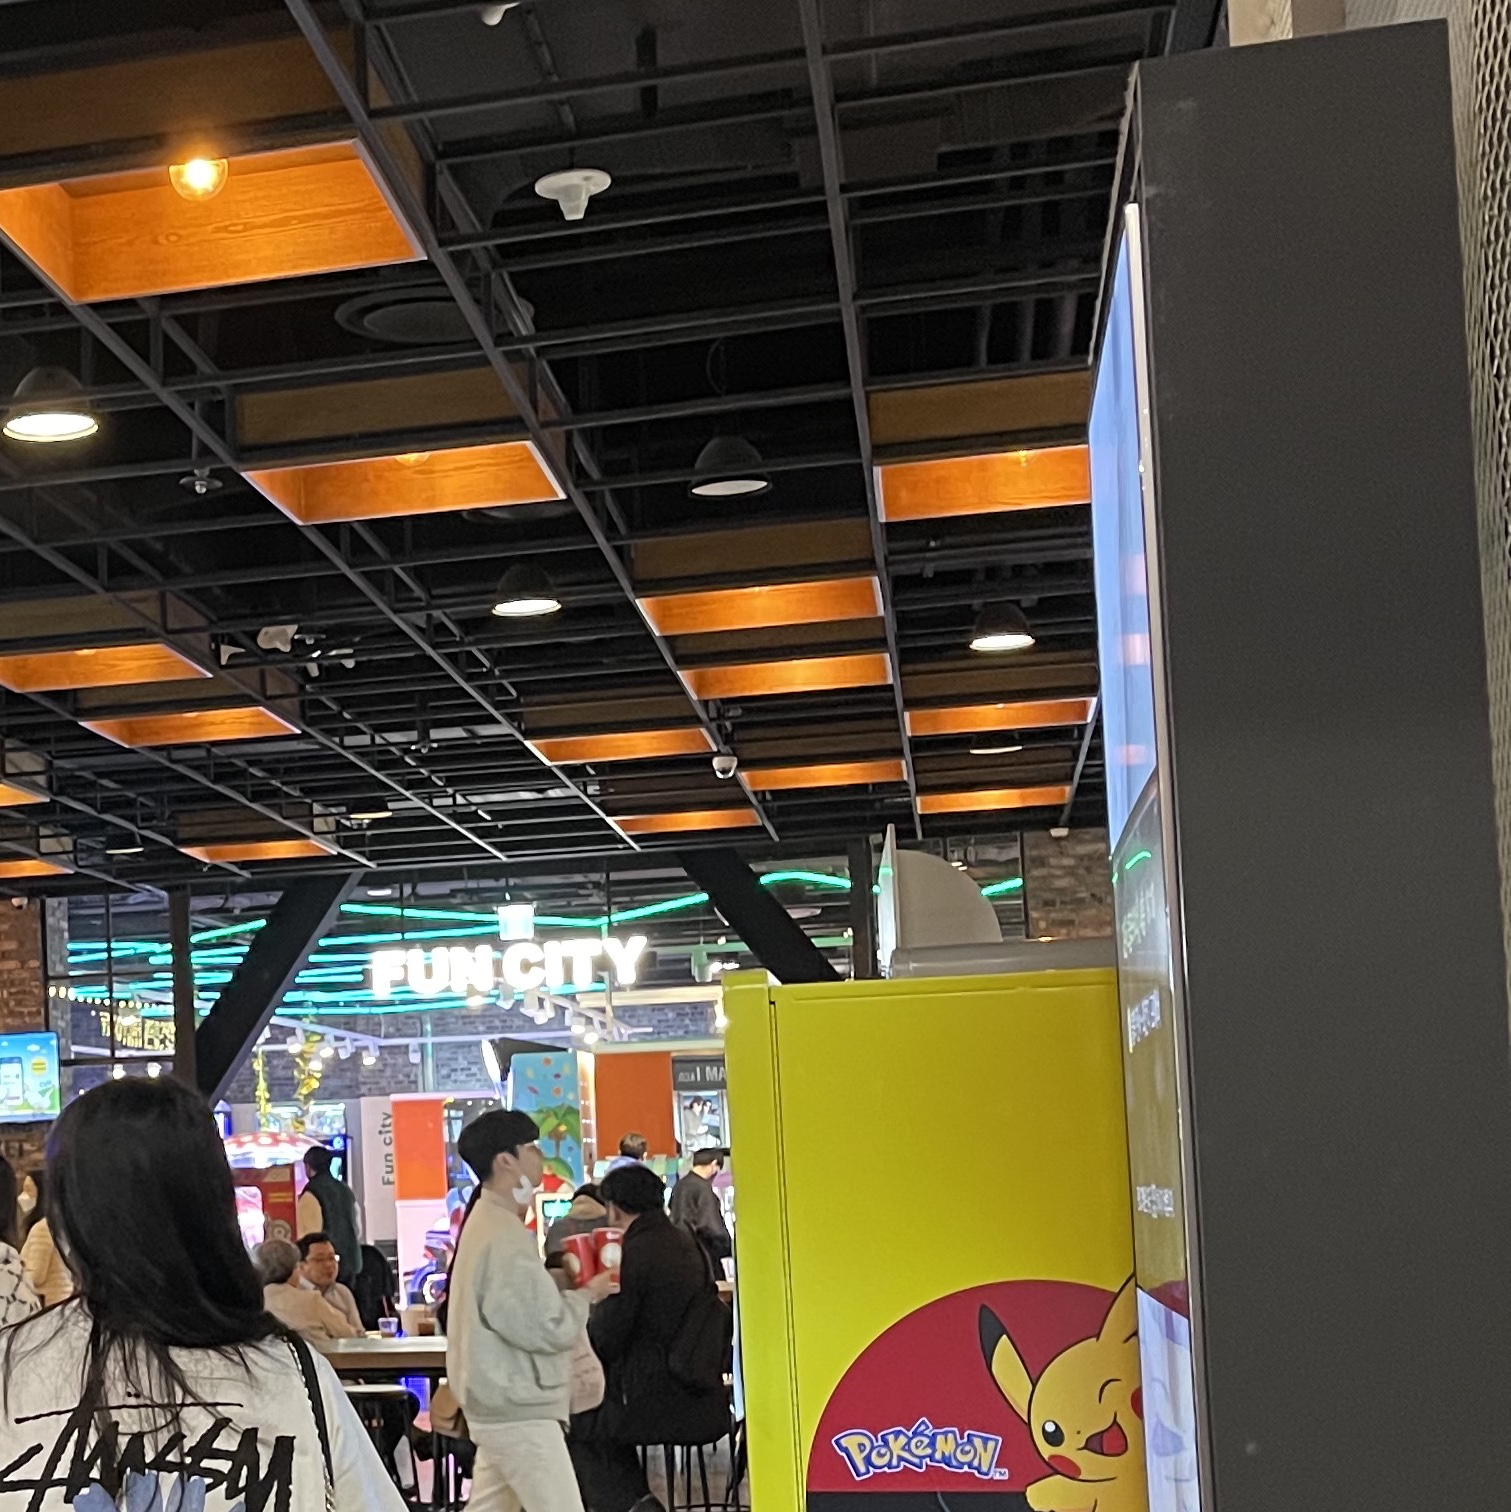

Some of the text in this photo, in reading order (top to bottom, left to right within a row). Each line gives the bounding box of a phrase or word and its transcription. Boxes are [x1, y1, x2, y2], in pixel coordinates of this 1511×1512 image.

[371, 935, 648, 998] FUN CITY
[378, 1111, 395, 1186] Fun city
[831, 1417, 1003, 1481] Pokémon
